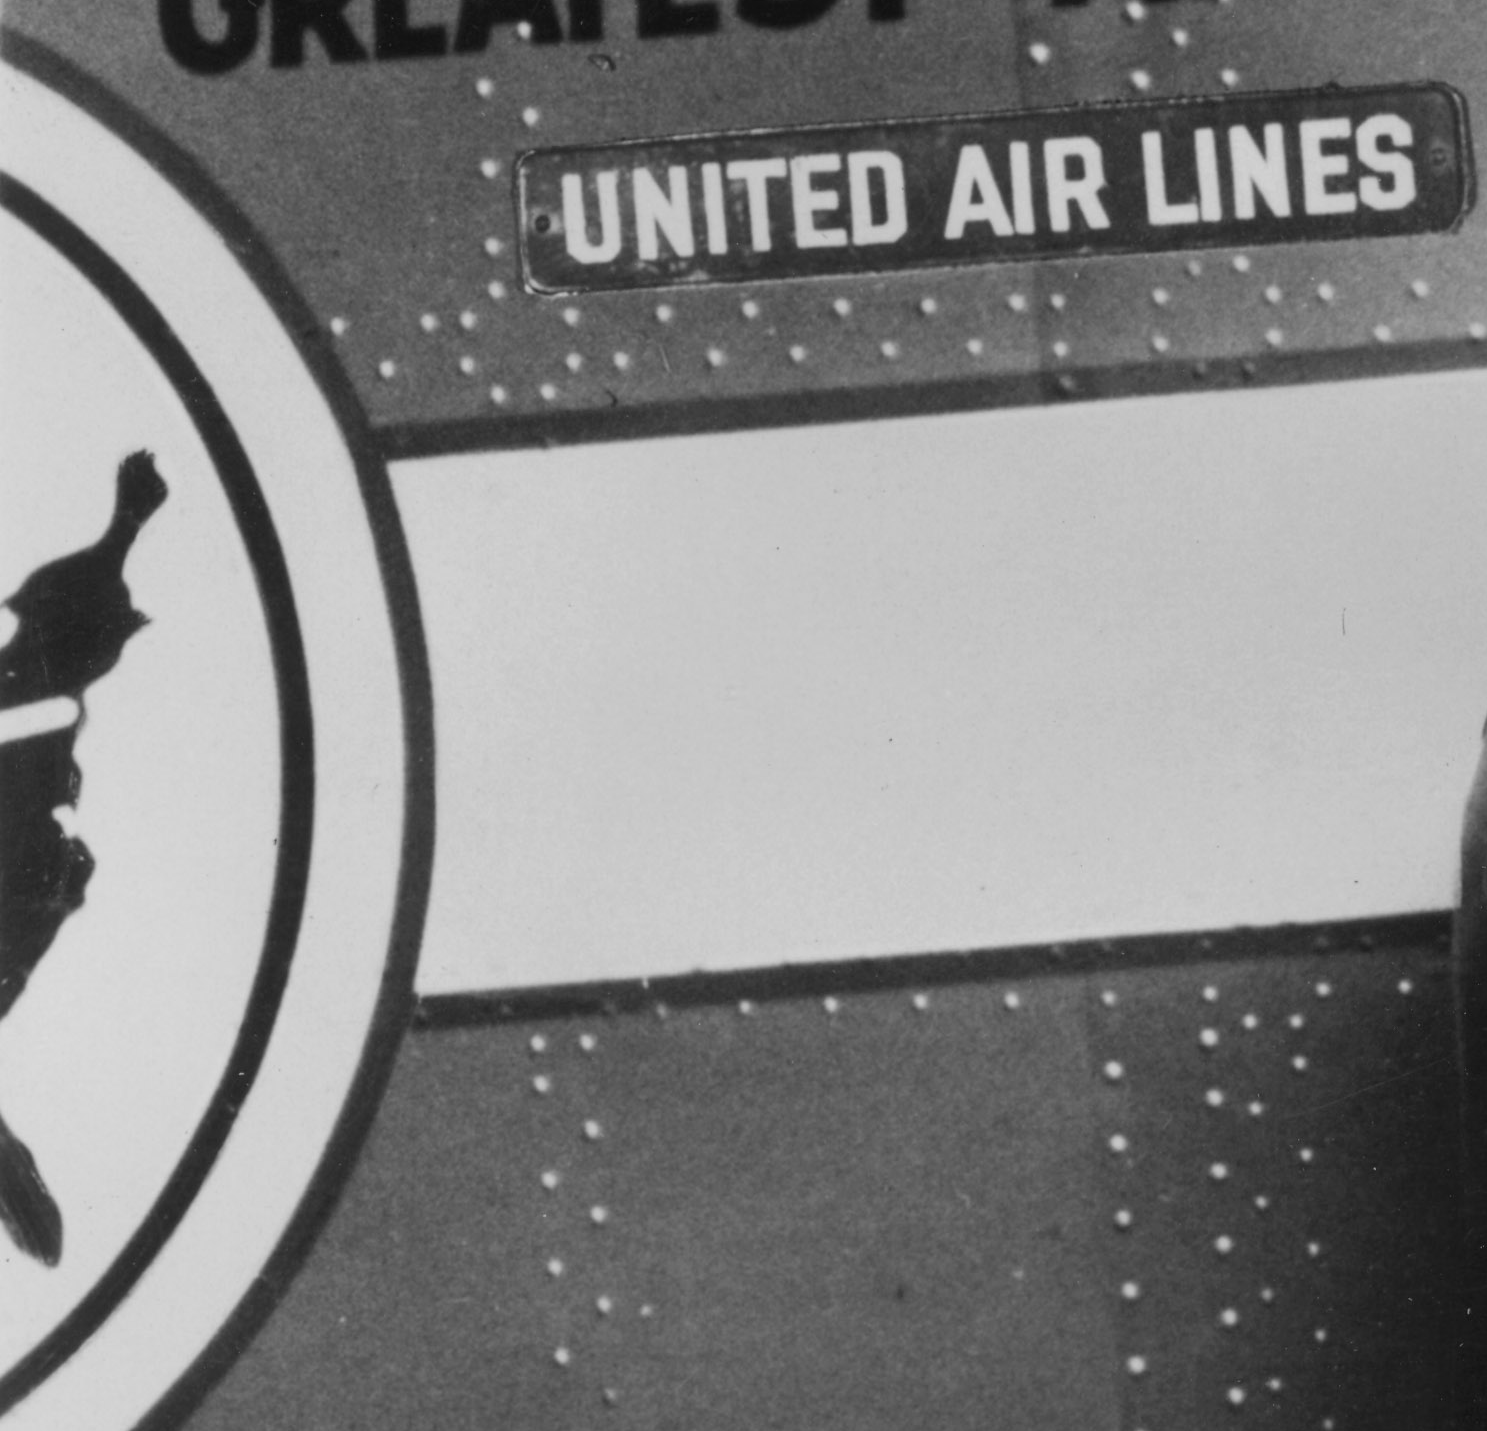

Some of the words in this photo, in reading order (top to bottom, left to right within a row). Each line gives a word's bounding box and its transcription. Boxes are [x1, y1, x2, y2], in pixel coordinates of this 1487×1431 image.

[560, 149, 908, 266] UNITED
[942, 131, 1112, 242] AIR
[1138, 112, 1418, 224] LINES
